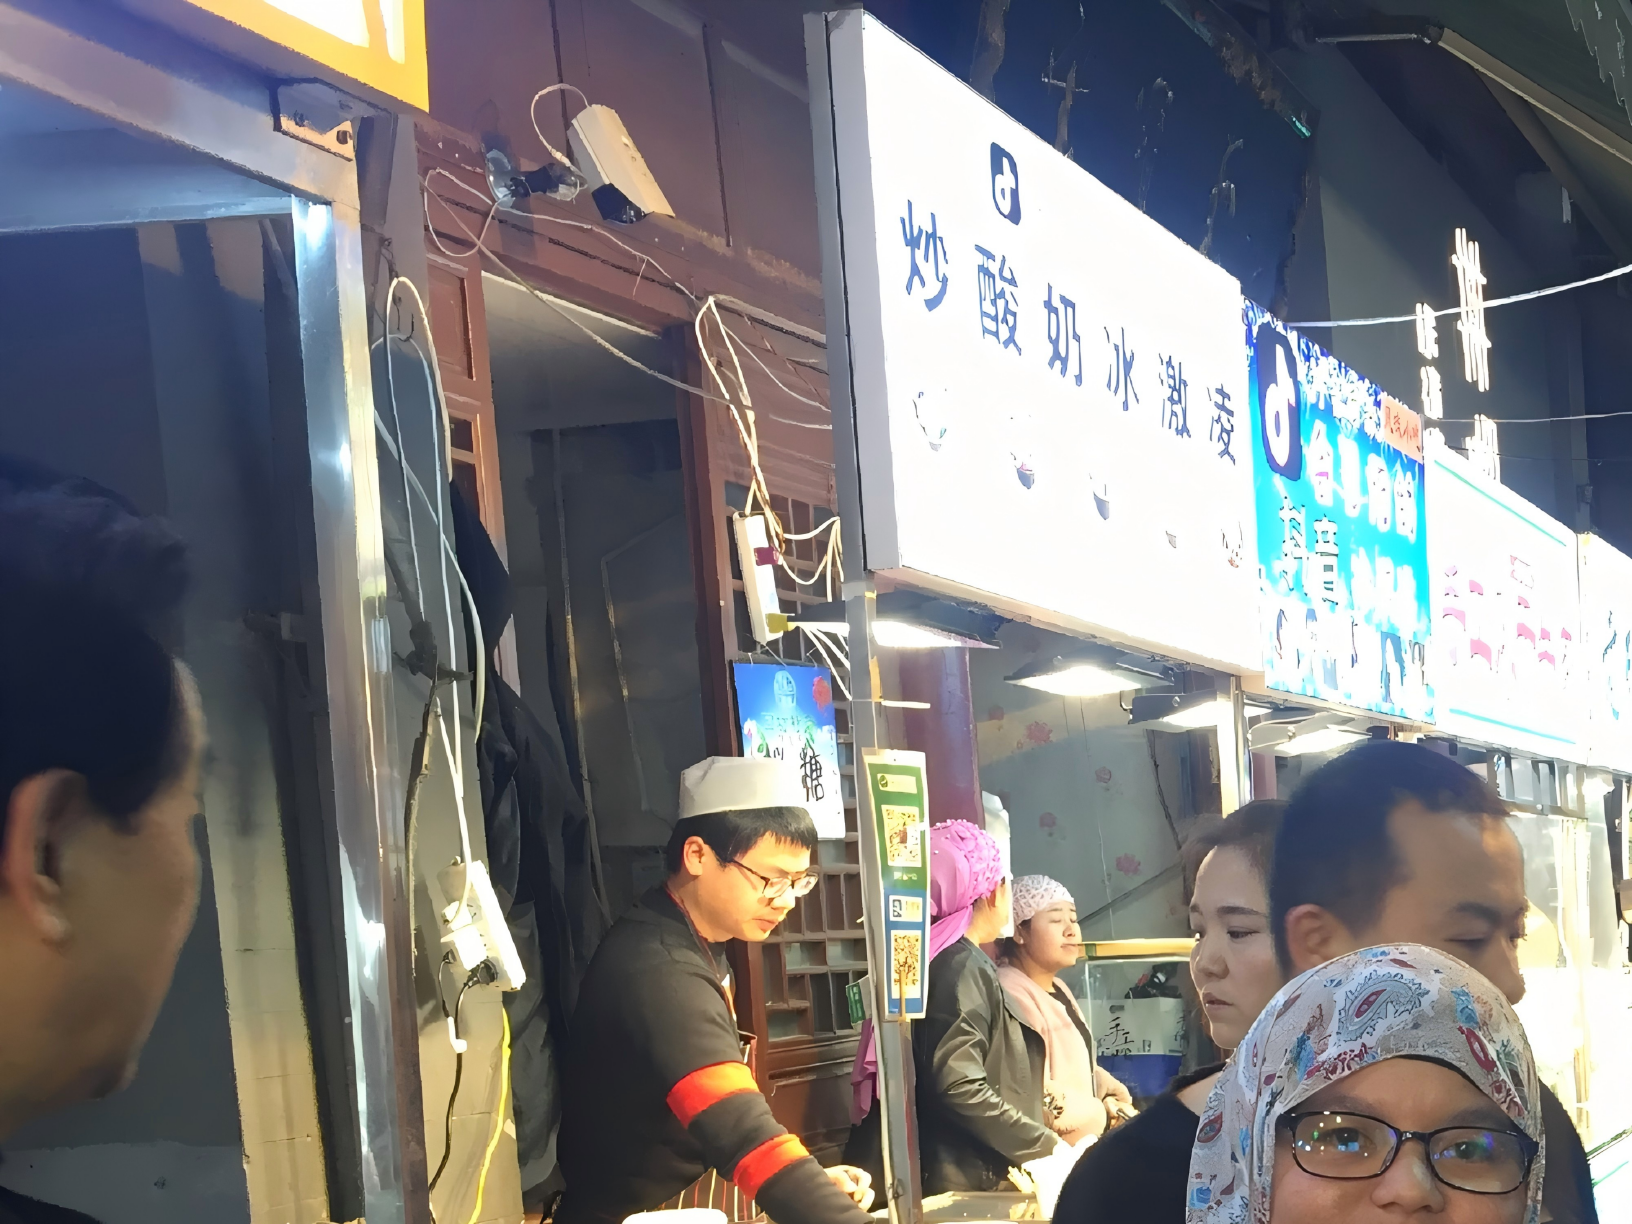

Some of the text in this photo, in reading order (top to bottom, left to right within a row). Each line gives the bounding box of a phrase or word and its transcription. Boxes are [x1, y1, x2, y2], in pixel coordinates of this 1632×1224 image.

[899, 199, 1236, 466] 炒酸奶冰激凌
